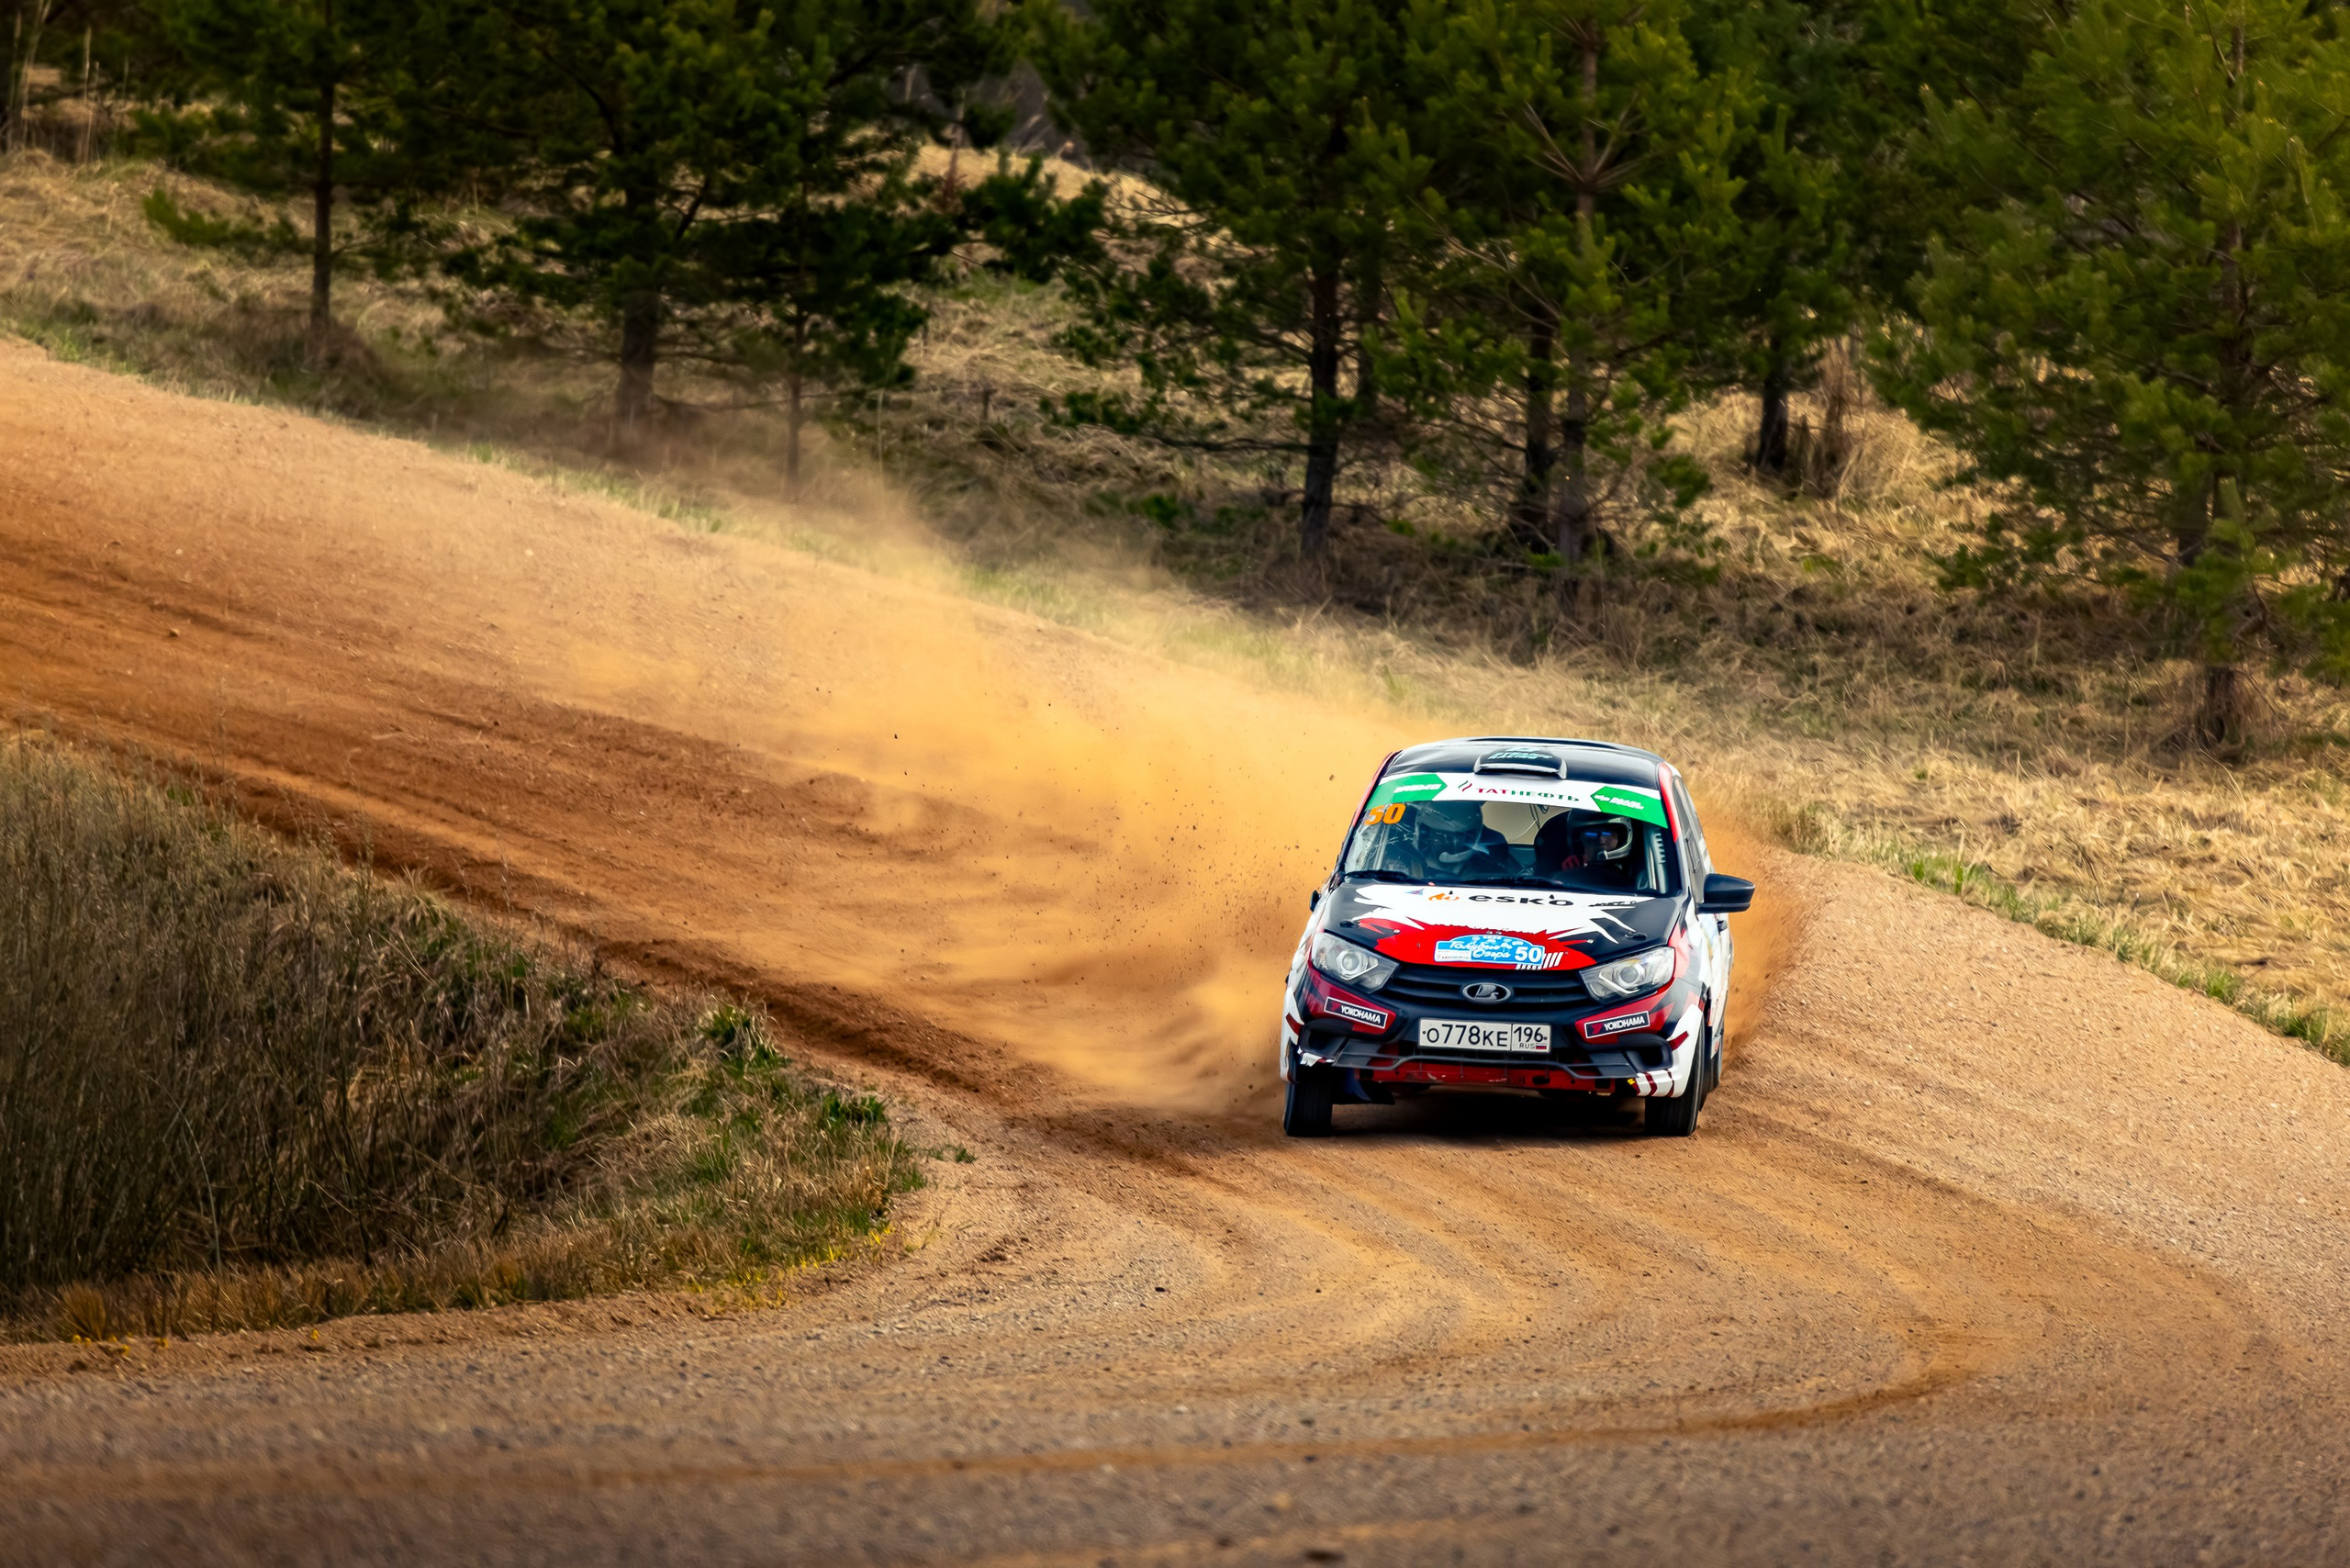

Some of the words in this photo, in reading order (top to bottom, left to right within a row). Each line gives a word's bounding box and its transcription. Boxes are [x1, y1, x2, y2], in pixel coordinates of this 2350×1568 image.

[1364, 802, 1406, 825] 50
[1468, 894, 1574, 906] esko
[1515, 946, 1542, 963] 50
[1340, 1005, 1382, 1025] YOKOHAMA
[1604, 1015, 1646, 1031] YOKOHAMA
